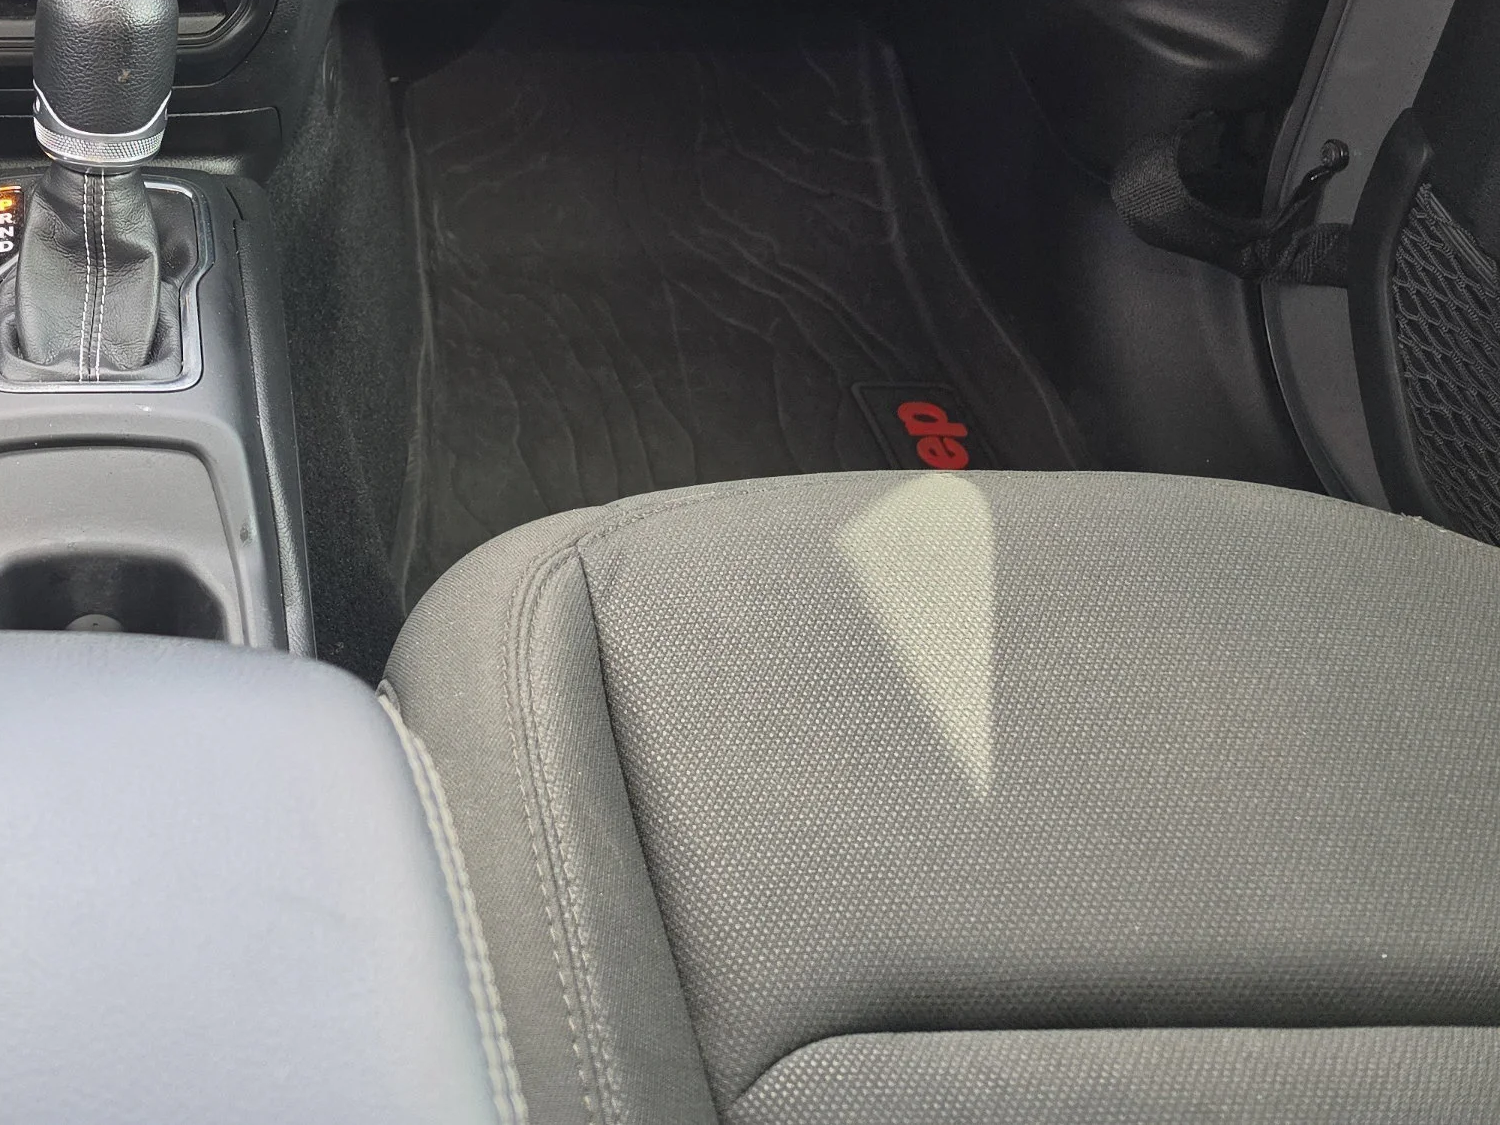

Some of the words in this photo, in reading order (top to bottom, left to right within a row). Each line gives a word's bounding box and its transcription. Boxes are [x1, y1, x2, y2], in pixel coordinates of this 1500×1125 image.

[0, 199, 13, 211] P
[0, 212, 14, 225] R
[0, 226, 14, 239] N
[897, 401, 968, 470] ep
